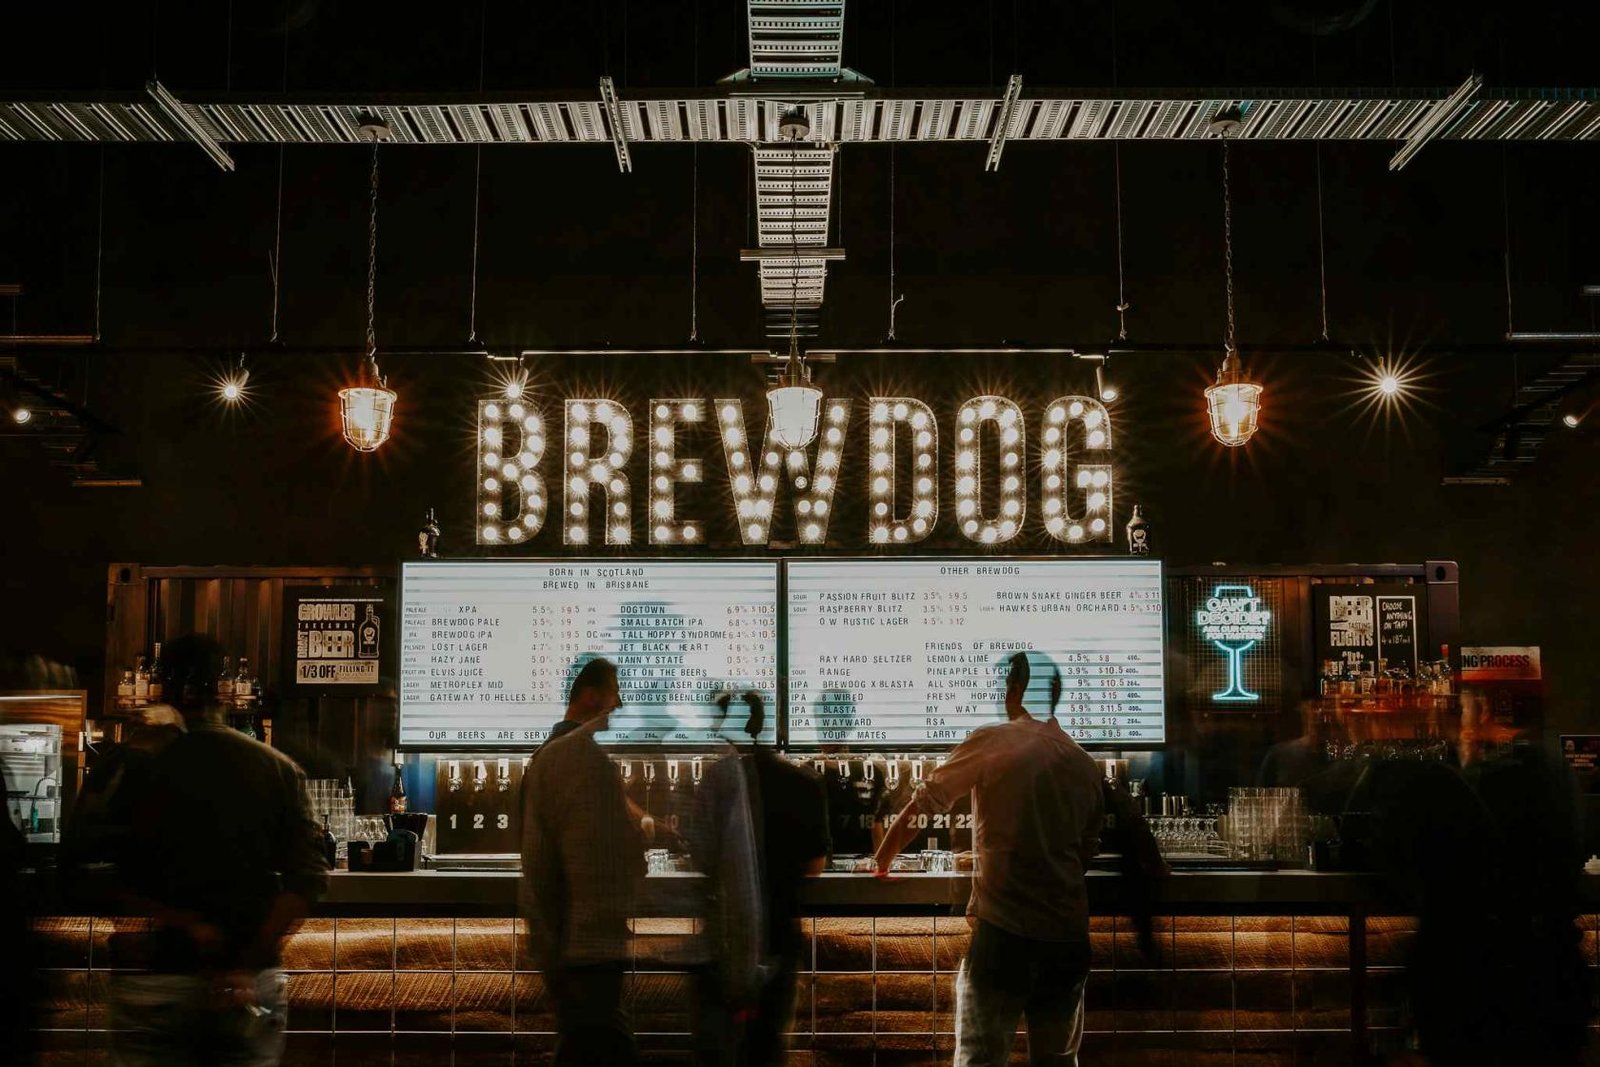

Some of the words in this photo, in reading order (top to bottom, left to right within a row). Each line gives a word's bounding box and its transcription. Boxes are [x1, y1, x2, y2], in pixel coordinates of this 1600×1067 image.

[475, 395, 1114, 545] BREWDOG
[549, 568, 574, 577] BORN
[580, 568, 590, 577] IN
[597, 568, 644, 577] SCOTLAND
[940, 567, 969, 576] OTHER
[976, 567, 1020, 576] BREWDOG
[543, 581, 579, 589] BREWED
[587, 581, 596, 589] IN
[606, 581, 649, 589] BRISBANE
[819, 592, 858, 600] PASSION
[861, 592, 887, 600] FRUIT
[891, 592, 916, 600] BLITZ
[996, 592, 1029, 600] BROWN
[1031, 592, 1061, 600] SNAKE
[1065, 592, 1096, 600] GINGER
[1100, 592, 1122, 600] BEER
[999, 604, 1038, 612] HAWKES
[1041, 604, 1070, 612] URBAN
[1076, 604, 1119, 612] ORCHARD
[1206, 598, 1260, 611] CAN'T
[1329, 595, 1373, 620] BEER
[298, 604, 355, 621] GROWLER
[620, 606, 666, 614] DOGTOWN
[819, 605, 873, 613] RASPBERRY
[877, 605, 903, 613] BLITZ
[431, 618, 474, 626] BREWDOG
[477, 618, 500, 626] PALE
[620, 618, 650, 626] SMALL
[655, 618, 684, 626] BATCH
[688, 618, 703, 626] IPA
[843, 618, 875, 626] RUSTIC
[880, 618, 909, 626] LAGER
[1330, 631, 1373, 646] FLIGHTS
[308, 630, 355, 658] BEER
[925, 642, 963, 650] FRIENDS
[973, 642, 984, 650] OF
[990, 642, 1034, 650] BREWDOG
[618, 656, 651, 664] NANNY
[655, 656, 684, 664] STATE
[819, 655, 838, 663] RAY
[843, 655, 868, 663] HARD
[873, 655, 912, 663] SELTZER
[927, 655, 956, 663] LEMON
[960, 655, 964, 663] &
[968, 655, 989, 663] LIME
[1480, 655, 1530, 668] PROCESS
[302, 664, 317, 678] 1/3
[319, 664, 336, 678] OFF
[430, 668, 455, 676] ELVIS
[458, 668, 483, 676] JUICE
[819, 668, 851, 676] RANGE
[619, 681, 658, 689] MALLOW
[664, 681, 693, 689] LASER
[696, 681, 725, 689] QUEST
[822, 680, 866, 688] BREWDOG
[871, 680, 876, 688] X
[879, 680, 914, 688] BLASTA
[928, 680, 944, 688] ALL
[948, 680, 978, 688] SHOOK
[986, 680, 997, 688] UP
[1077, 680, 1090, 688] 9%
[430, 694, 474, 702] GATEWAY
[480, 694, 490, 702] TO
[494, 694, 526, 702] HELLES
[622, 694, 653, 702] EWDOG
[656, 694, 667, 702] VS
[669, 694, 715, 702] BEENLEIGH
[791, 693, 806, 701] IPA
[834, 693, 864, 701] WIRED
[927, 693, 956, 701] FRESH
[971, 693, 1006, 701] HOPWIR
[1070, 693, 1090, 701] 7.3%
[1102, 693, 1117, 701] $15
[822, 718, 872, 726] WAYWARD
[926, 718, 946, 726] RSA
[1102, 718, 1117, 726] $12
[428, 731, 447, 739] OUR
[457, 731, 486, 739] BEERS
[497, 731, 514, 739] ARE
[450, 814, 457, 828] 1
[474, 814, 484, 828] 2
[497, 814, 508, 828] 3
[907, 814, 928, 828] 20
[933, 814, 950, 828] 21
[956, 814, 974, 828] 22
